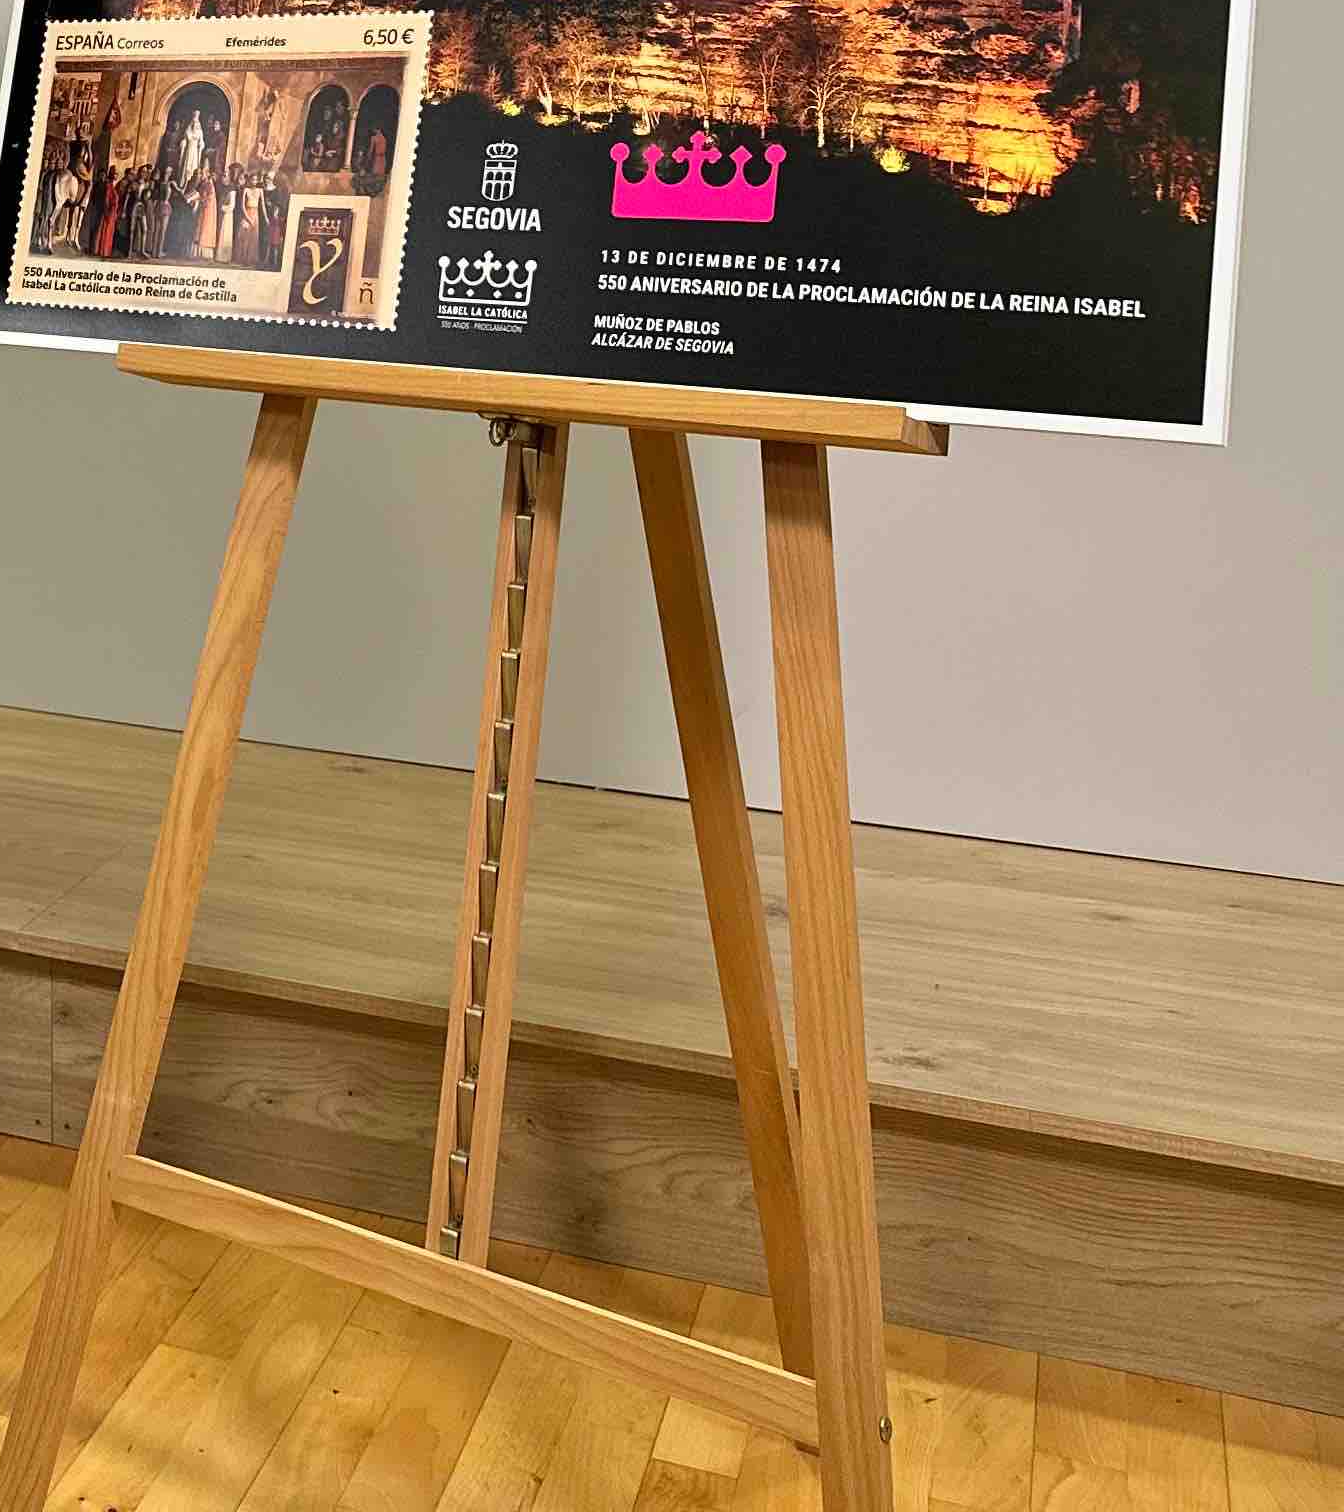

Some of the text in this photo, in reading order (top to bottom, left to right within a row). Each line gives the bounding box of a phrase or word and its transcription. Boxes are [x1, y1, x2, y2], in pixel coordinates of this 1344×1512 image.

[56, 31, 164, 50] ESPAÑA Correos
[225, 36, 286, 48] Efemérides
[363, 28, 415, 47] 6,50 €
[447, 206, 542, 232] SEGOVIA
[601, 249, 841, 273] 13 DE DICIEMBRE DE 1474
[24, 266, 226, 289] 550 Aniversario de la Proclamación de
[22, 278, 237, 302] Isabel La Católica como Reina de Castilla
[598, 274, 1146, 318] 550 ANIVERSARIO DE LA PROCLAMACIÓN DE LA REINA ISABEL
[438, 304, 528, 319] ISABEL LA CATÓLICA
[594, 313, 720, 335] MUÑOZ DE PABLOS
[591, 332, 734, 355] ALCÁZAR DE SEGOVIA
